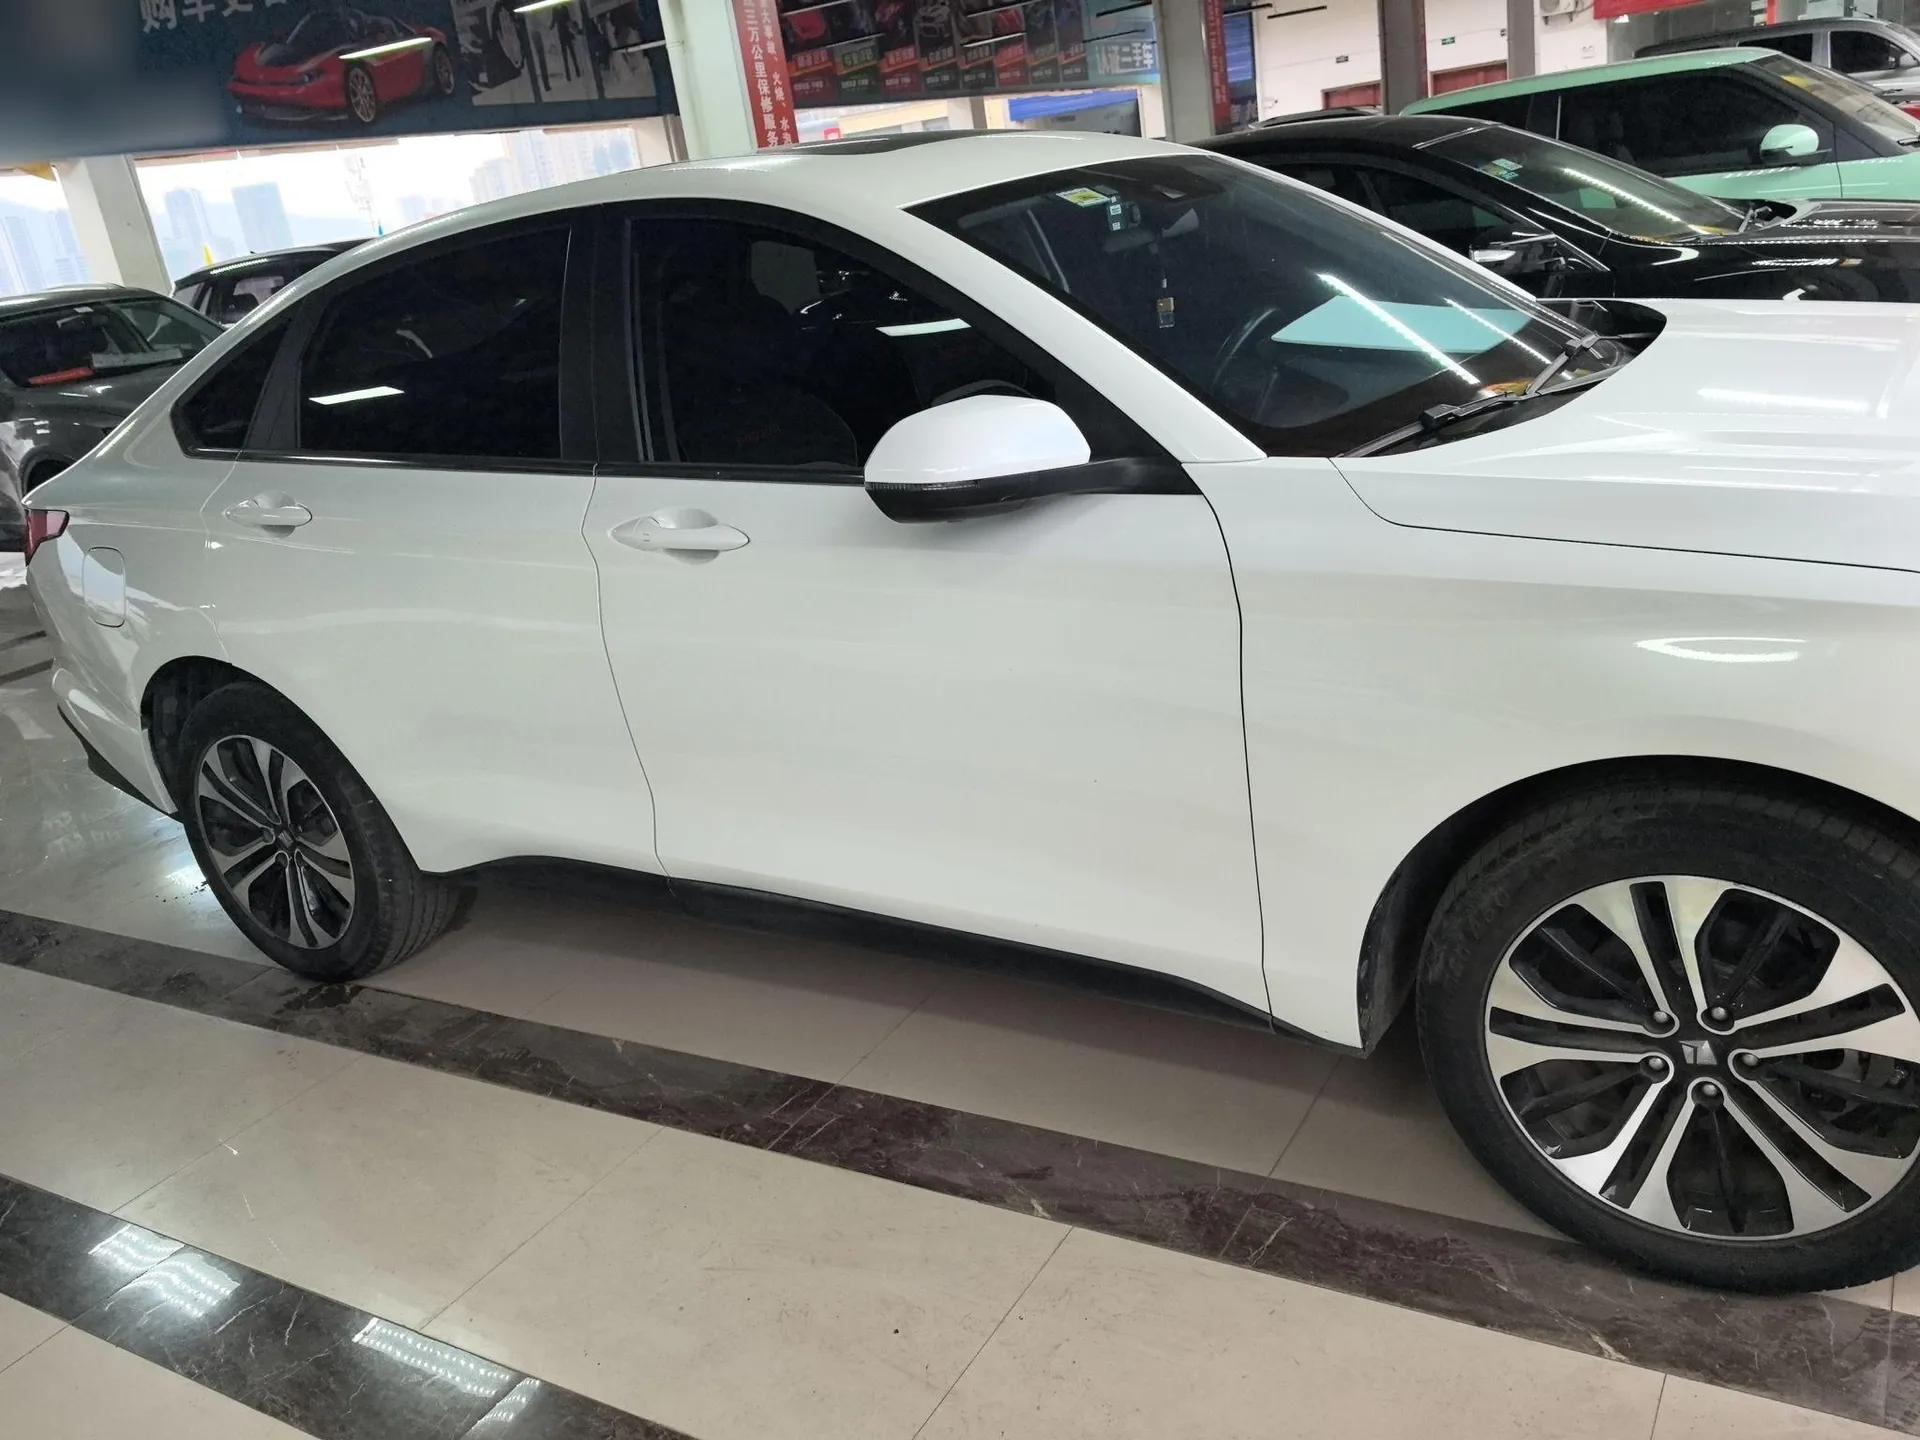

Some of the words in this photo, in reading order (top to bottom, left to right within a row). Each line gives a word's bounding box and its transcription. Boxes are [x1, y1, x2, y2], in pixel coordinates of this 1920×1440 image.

[743, 0, 779, 146] 三万公里保修服务
